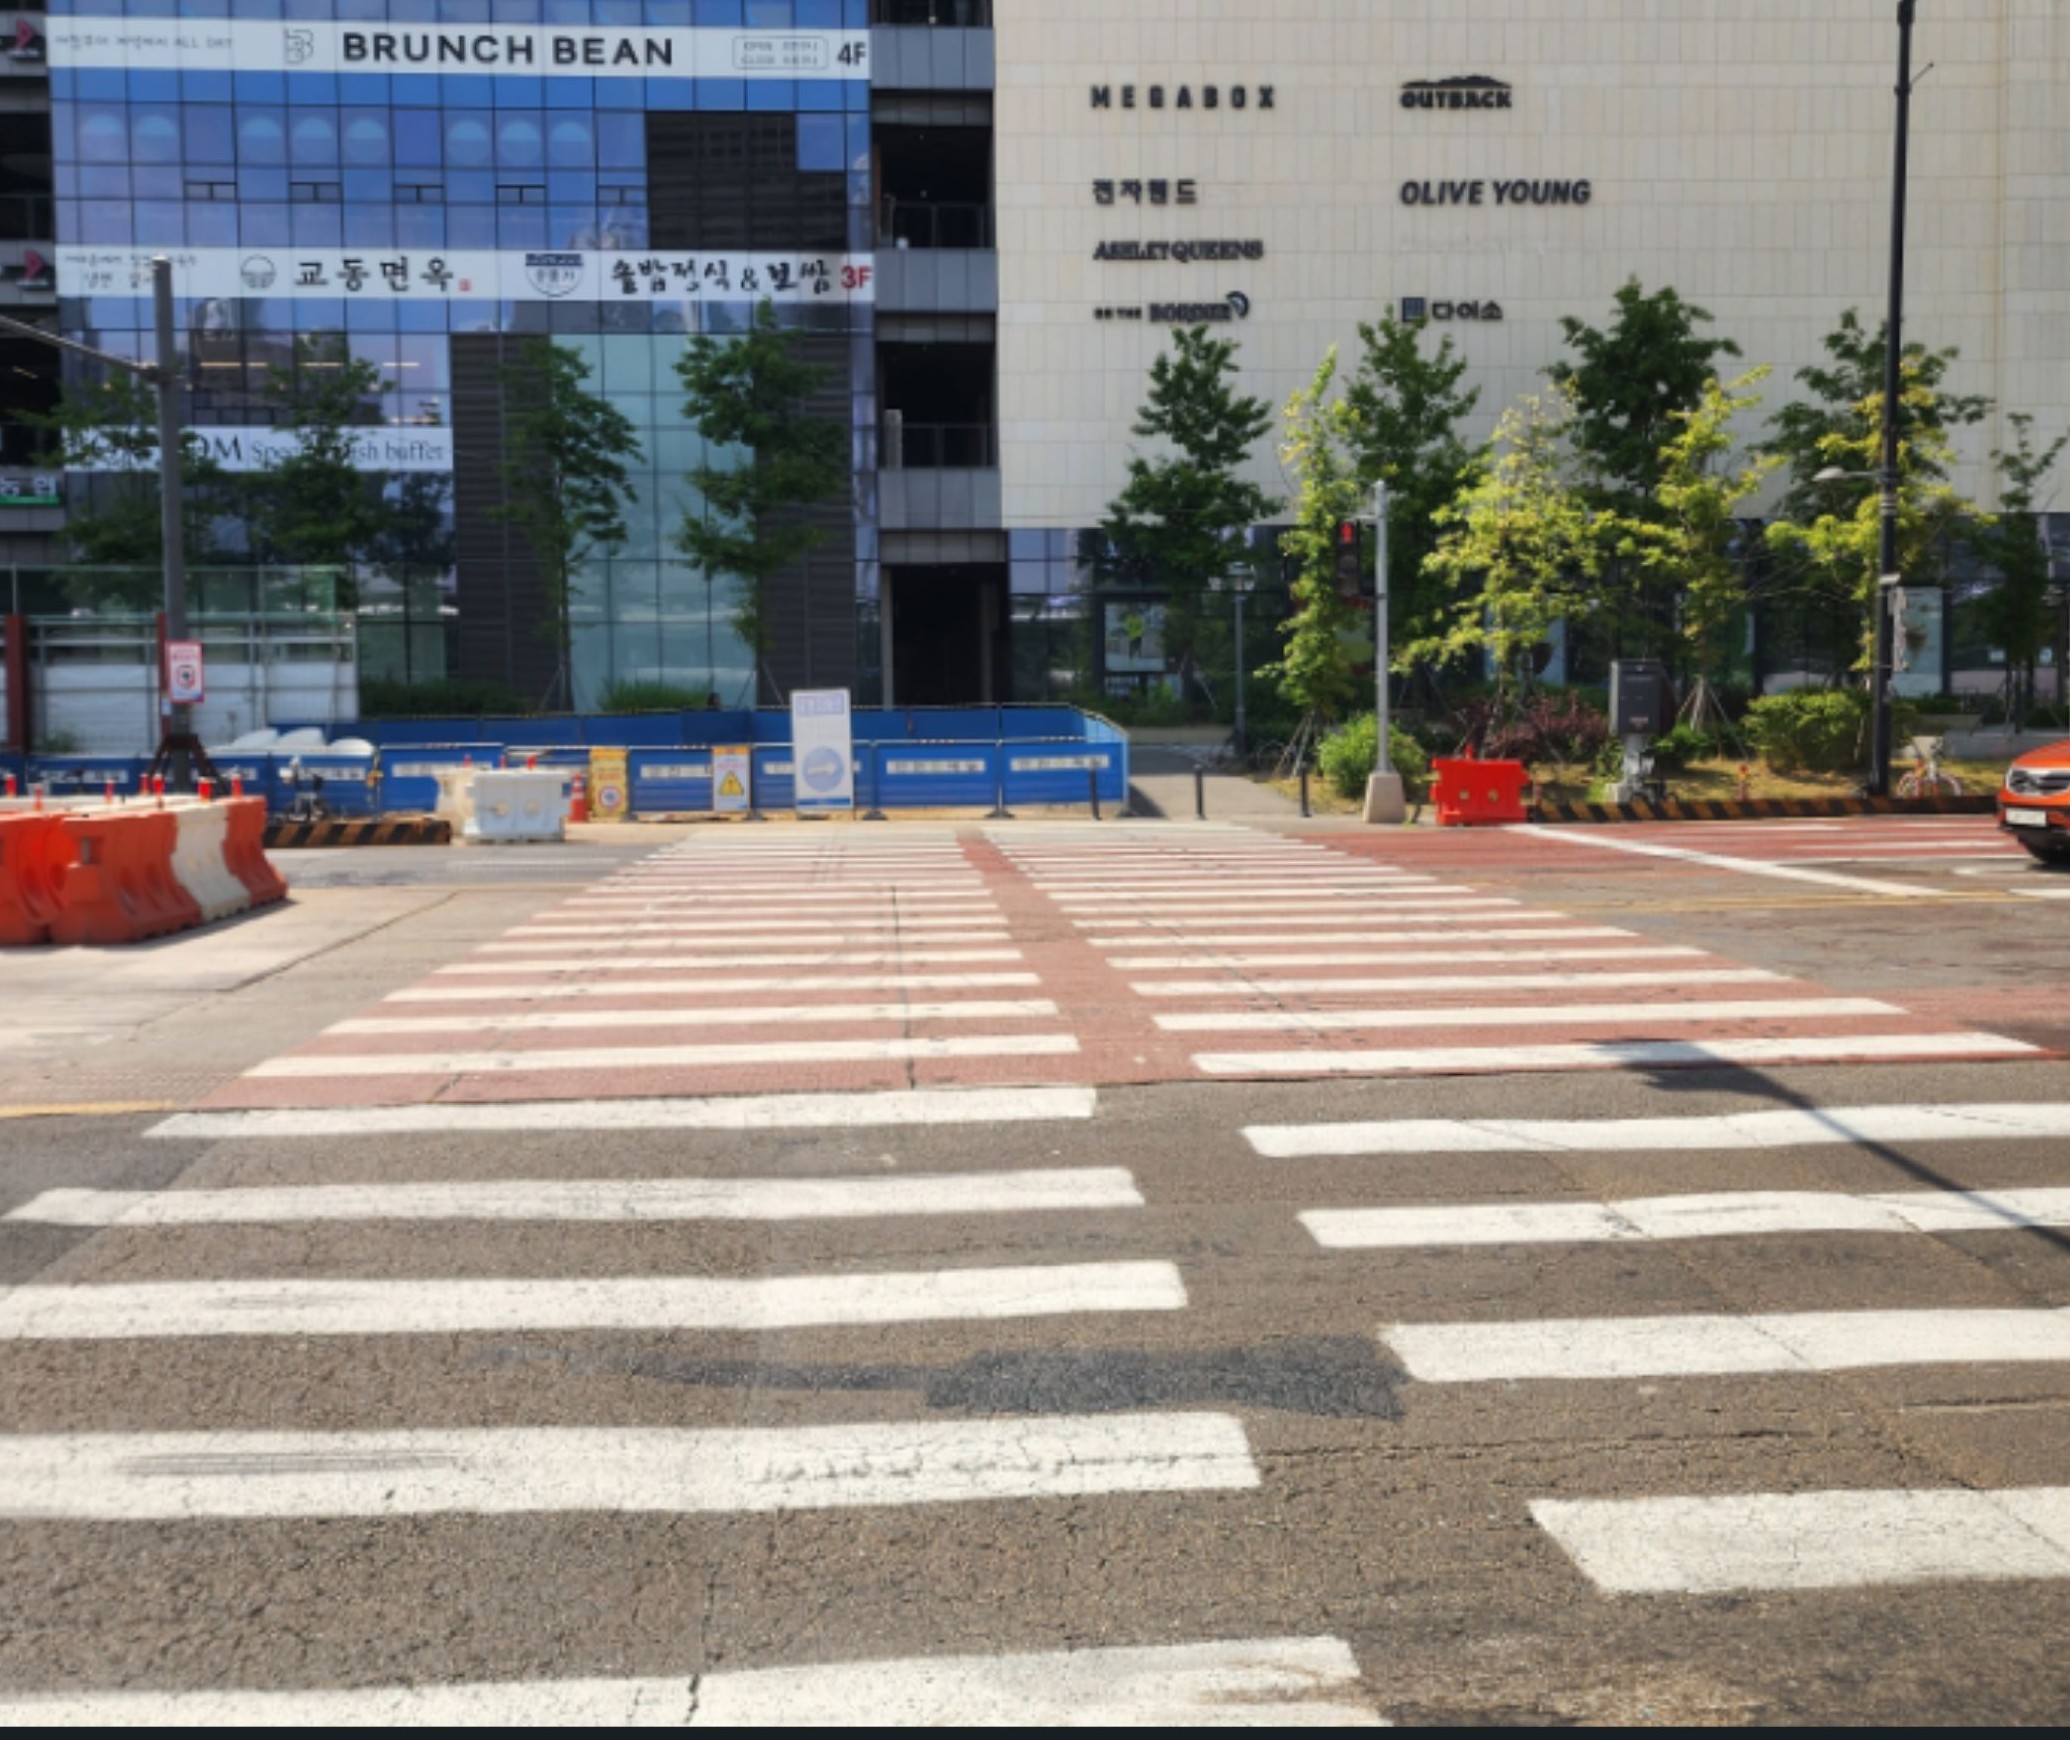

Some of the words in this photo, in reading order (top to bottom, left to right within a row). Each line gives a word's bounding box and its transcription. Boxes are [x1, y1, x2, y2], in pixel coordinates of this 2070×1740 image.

[344, 32, 534, 64] BRUNCH
[552, 36, 674, 66] BEAN
[838, 41, 866, 66] 4F
[1091, 85, 1274, 108] MEGABOX
[1400, 90, 1512, 109] OUTBACK
[1400, 180, 1484, 205] OLIVE
[1493, 178, 1591, 205] YOUNG
[294, 256, 454, 292] 교동면옥
[841, 265, 873, 289] 3F
[1432, 300, 1503, 319] 다이소
